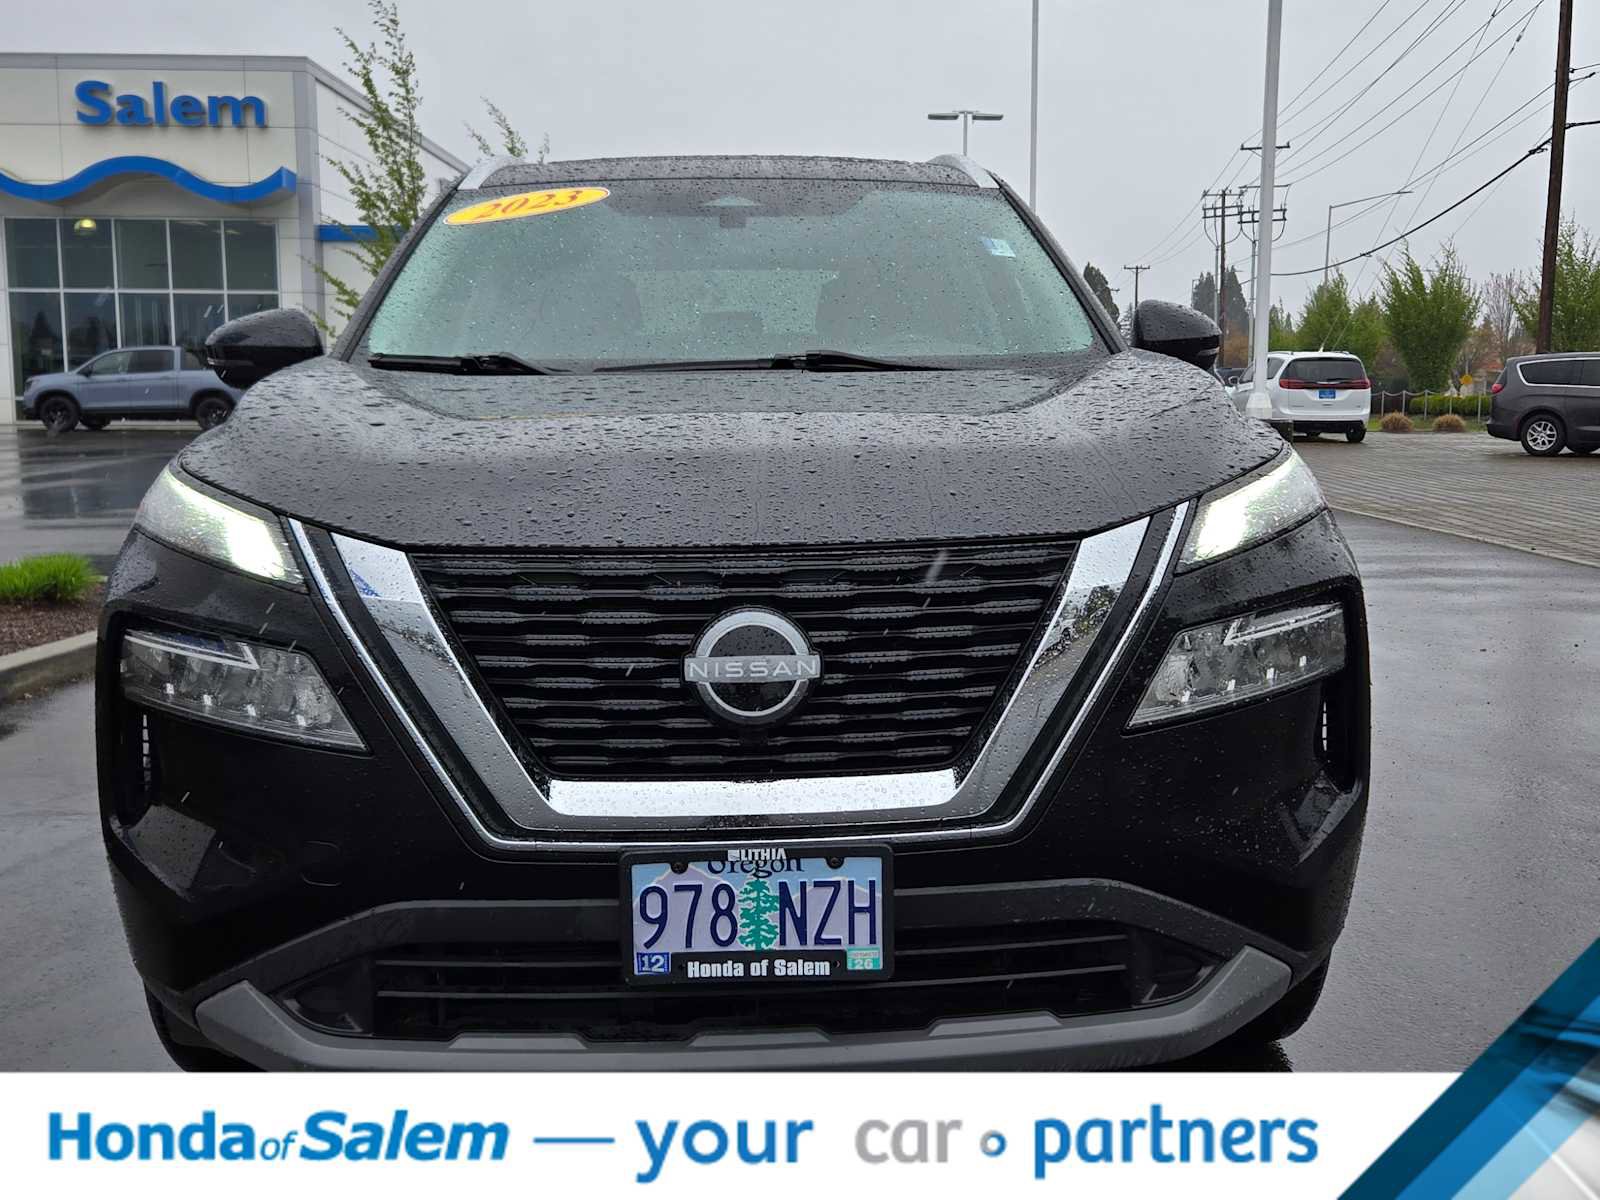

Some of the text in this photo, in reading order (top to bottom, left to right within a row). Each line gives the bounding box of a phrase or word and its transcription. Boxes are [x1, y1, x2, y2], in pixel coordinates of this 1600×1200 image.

[75, 80, 267, 128] Salem
[475, 190, 582, 220] 2023
[689, 660, 816, 678] NISSAN
[741, 848, 787, 861] LITHIA
[707, 859, 805, 879] Oregon
[640, 880, 878, 950] 978 NZH
[641, 954, 665, 972] 12
[687, 959, 831, 978] Honda of Salem
